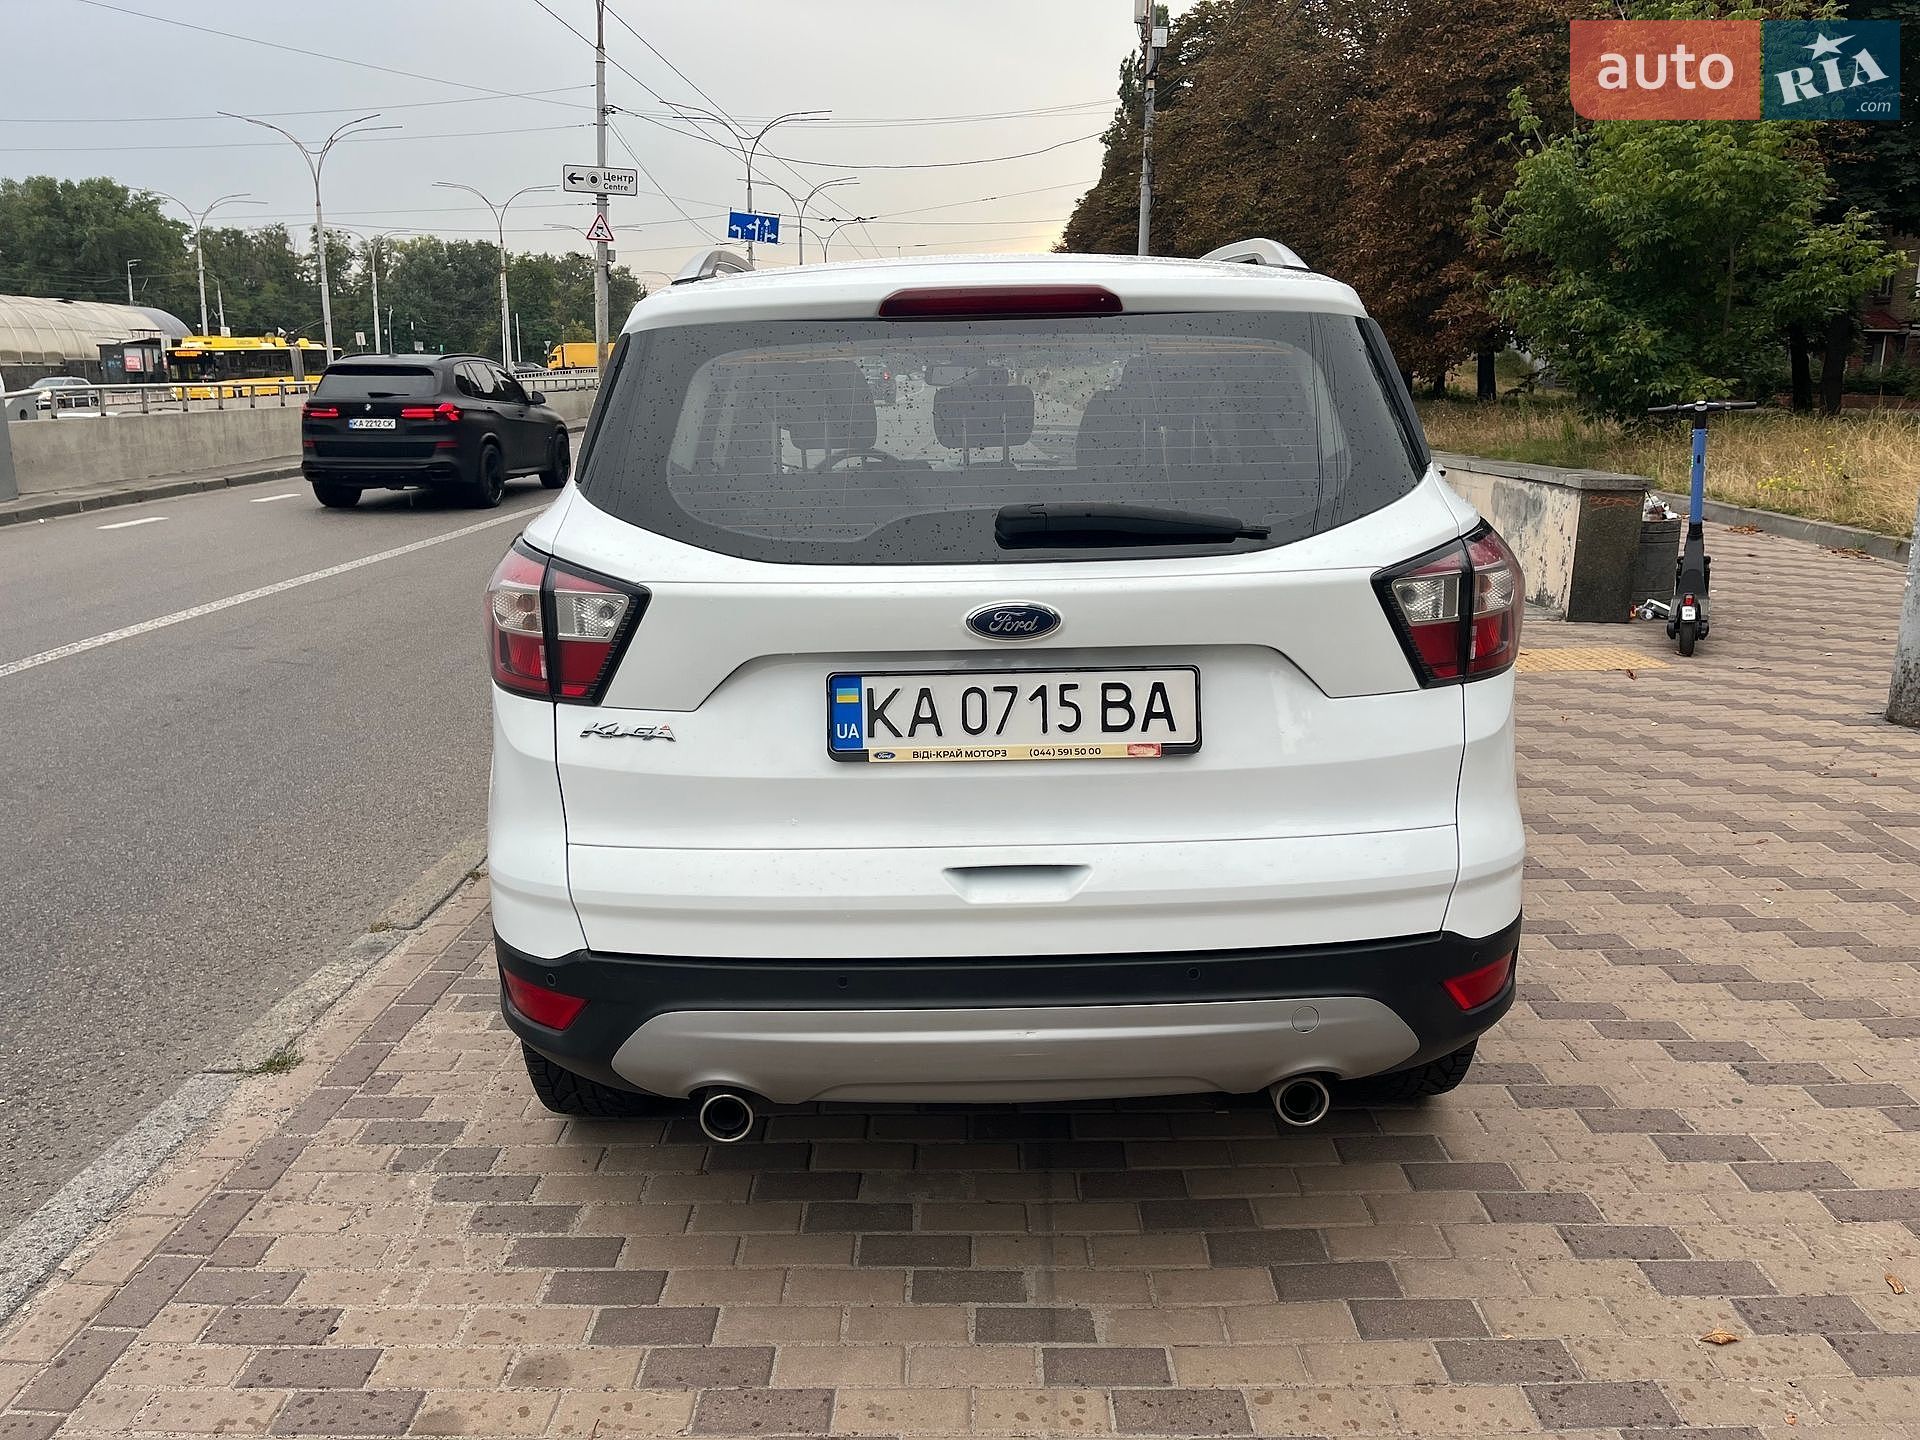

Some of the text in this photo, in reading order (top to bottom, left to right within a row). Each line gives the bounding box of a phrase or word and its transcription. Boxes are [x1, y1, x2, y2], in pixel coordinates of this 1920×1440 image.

[603, 172, 634, 184] Центр
[603, 183, 629, 191] Centre
[989, 611, 1039, 632] Ford
[866, 682, 1177, 738] KA 0715 BA
[836, 723, 860, 739] UA
[964, 750, 1007, 758] МОТОРЗ
[1029, 748, 1056, 757] (044)
[1057, 748, 1073, 756] 591
[1088, 747, 1102, 755] 00
